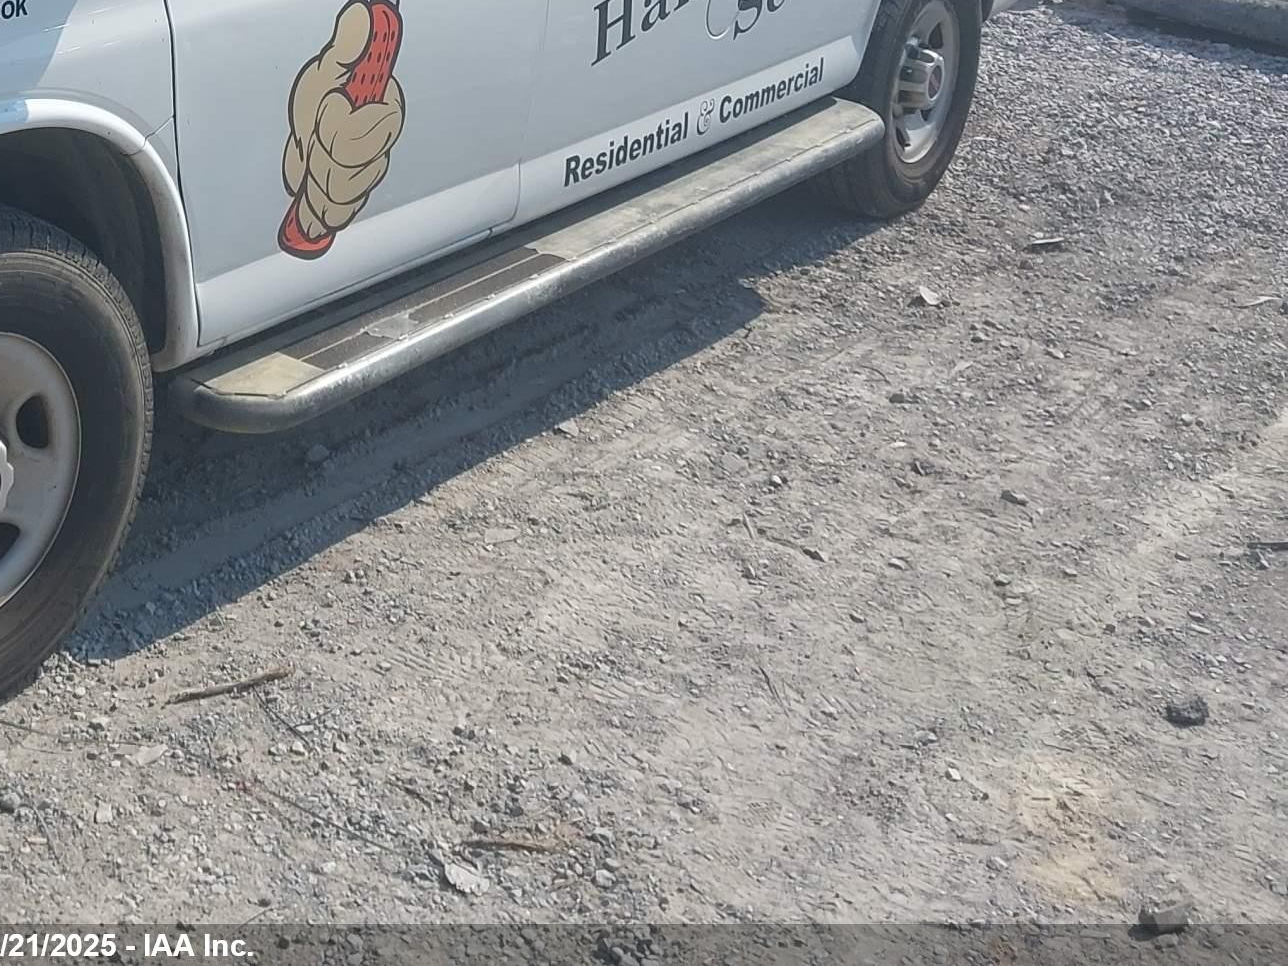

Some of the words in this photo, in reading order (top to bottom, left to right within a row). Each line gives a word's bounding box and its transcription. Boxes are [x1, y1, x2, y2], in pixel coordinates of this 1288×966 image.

[564, 112, 689, 188] Residential
[696, 98, 715, 136] &
[719, 57, 825, 124] Commercial
